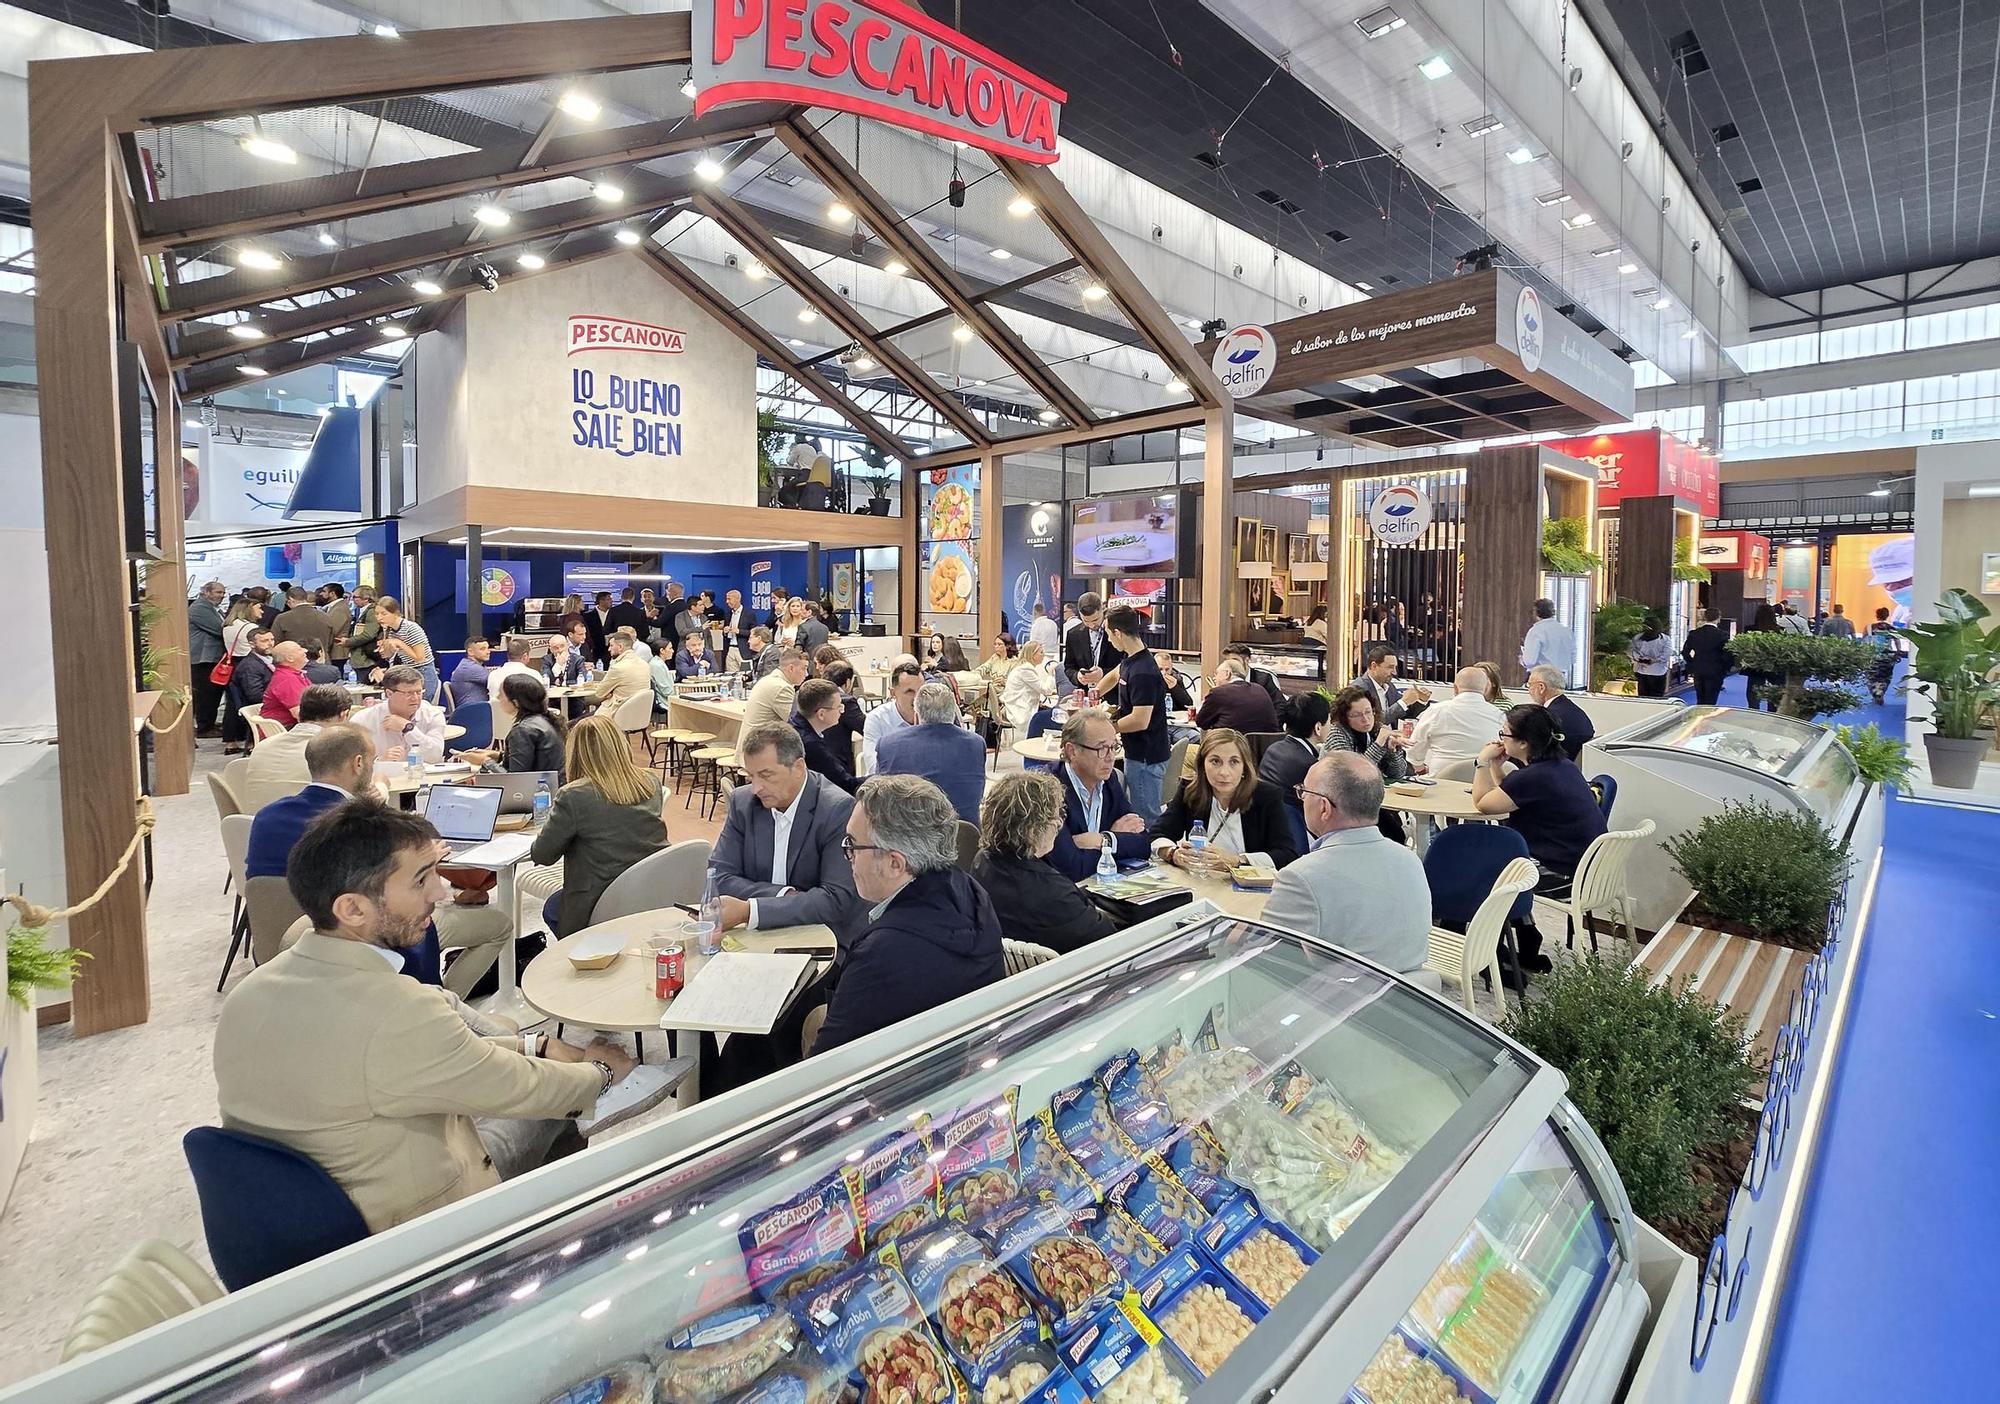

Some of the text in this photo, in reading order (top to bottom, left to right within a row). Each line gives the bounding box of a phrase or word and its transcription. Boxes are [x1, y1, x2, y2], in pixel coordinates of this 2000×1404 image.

[711, 0, 1058, 151] PESCANOVA
[572, 324, 683, 350] PESCANOVA
[1290, 303, 1477, 356] el sabor de los mejores momentos
[1221, 363, 1265, 387] delfín
[572, 368, 682, 417] LO BUENO
[572, 409, 682, 456] SALE BIEN
[1378, 517, 1420, 535] delfín
[326, 554, 357, 562] Aligato
[946, 1110, 988, 1146] PESCANOVA
[1062, 1118, 1094, 1139] Gambas
[757, 1197, 823, 1244] PESCANOVA
[760, 1246, 814, 1272] Gambón
[1119, 1301, 1142, 1328] GRATIS
[1070, 1326, 1099, 1360] PESCANOVA
